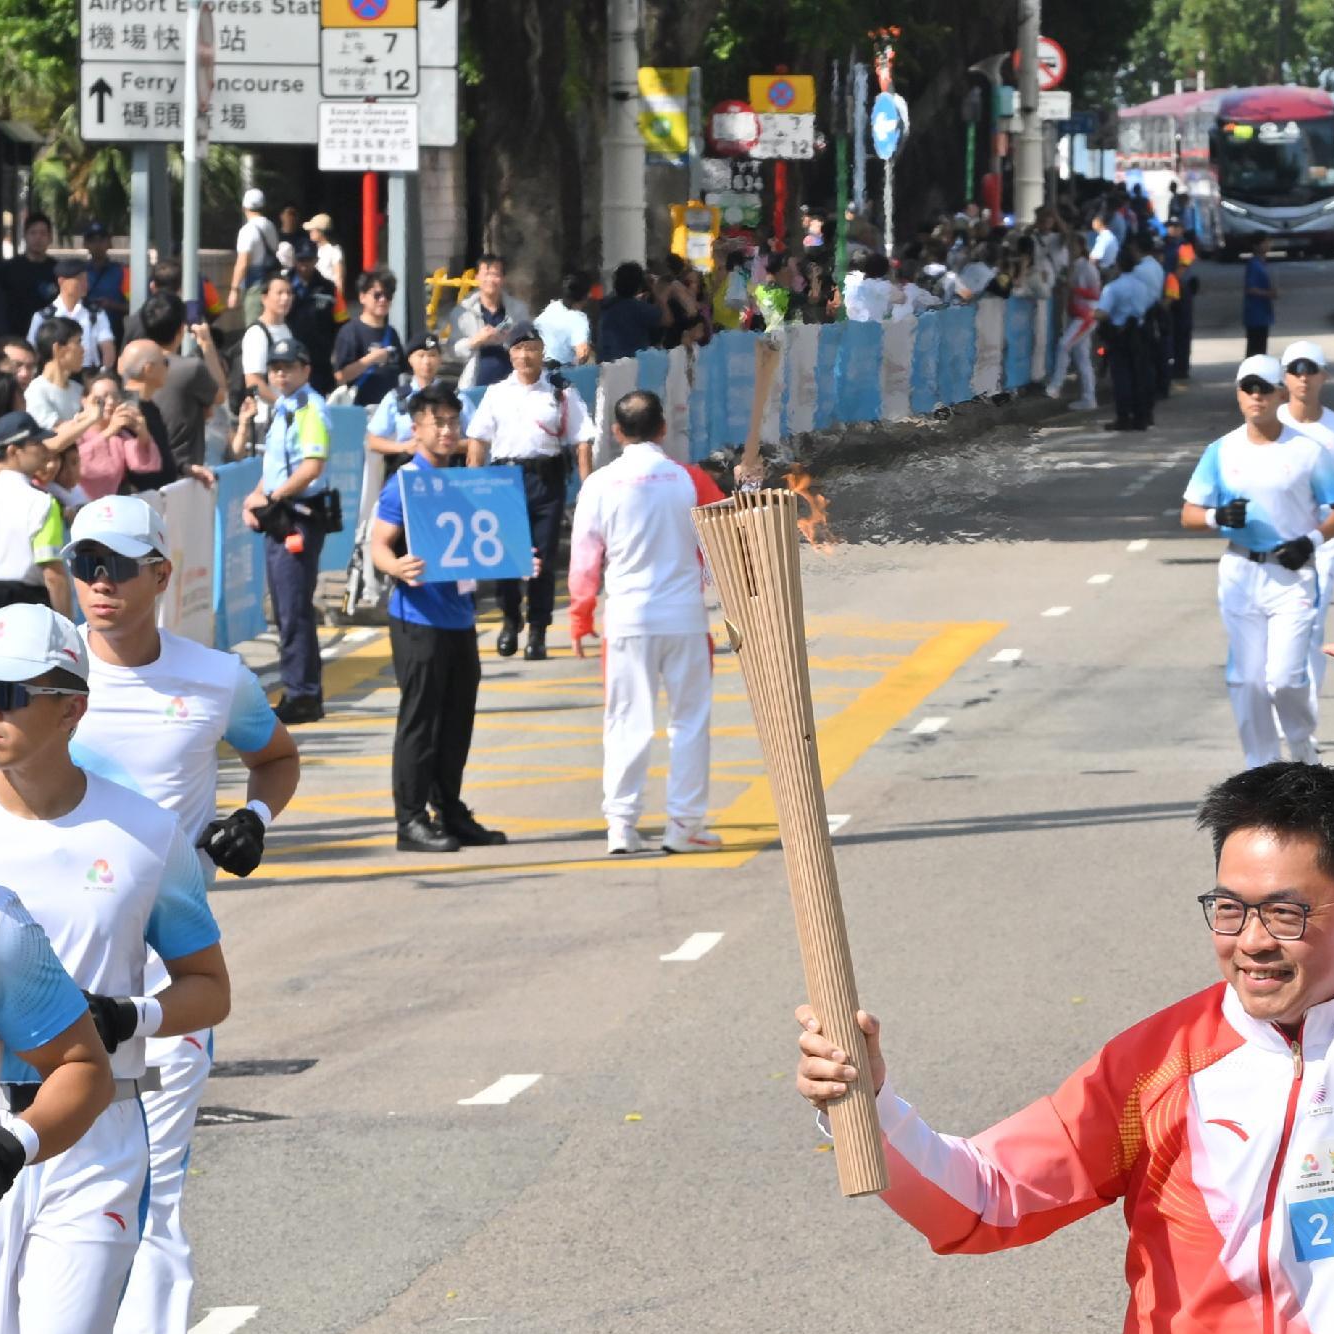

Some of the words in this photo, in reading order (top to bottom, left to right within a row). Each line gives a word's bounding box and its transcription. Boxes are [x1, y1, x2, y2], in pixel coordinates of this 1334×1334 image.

[88, 0, 167, 16] Airport
[176, 0, 262, 15] Eress
[89, 24, 246, 51] 機場快站
[383, 32, 398, 54] 7
[121, 72, 178, 93] Ferry
[384, 69, 410, 91] 12
[435, 508, 505, 568] 28
